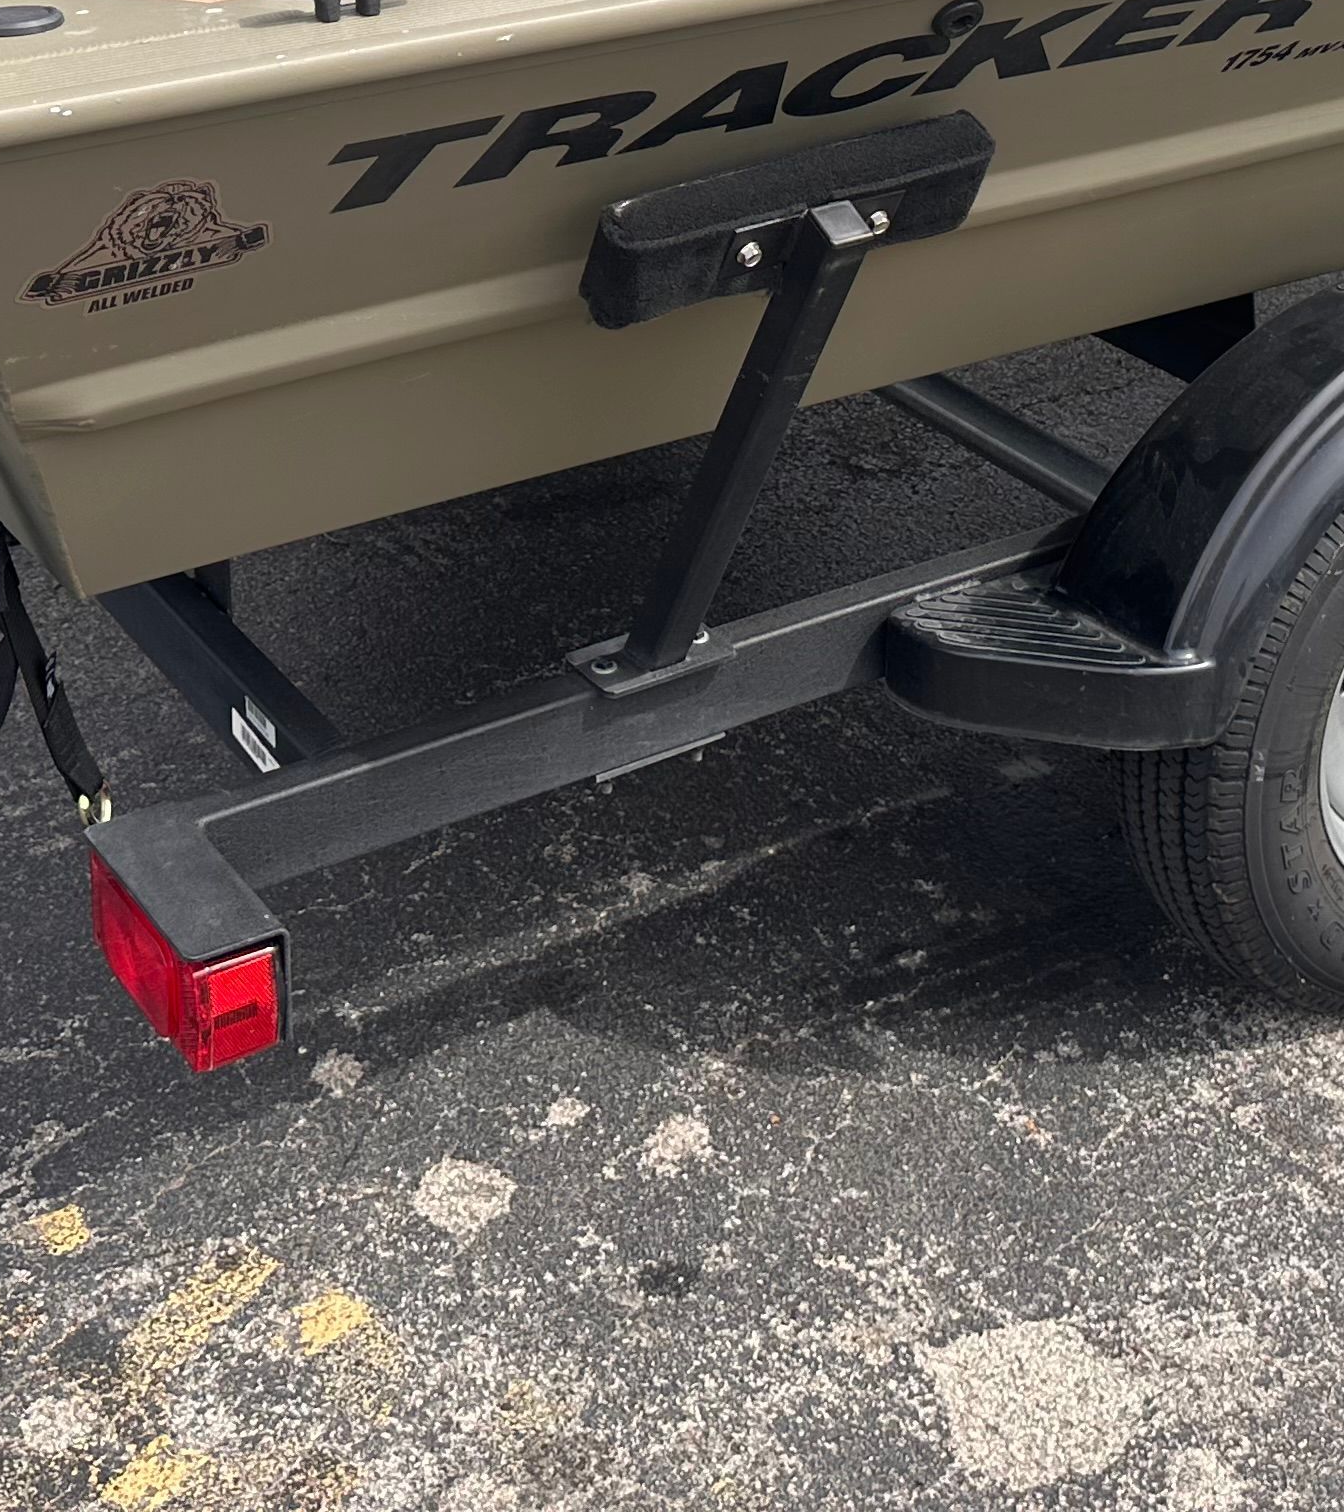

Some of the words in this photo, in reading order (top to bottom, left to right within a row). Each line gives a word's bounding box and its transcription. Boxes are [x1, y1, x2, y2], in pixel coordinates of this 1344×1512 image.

[1221, 40, 1301, 73] 1754
[77, 245, 220, 292] GRIZZLY
[87, 295, 119, 314] ALL
[122, 277, 195, 306] WELDED
[1278, 767, 1314, 895] STAR
